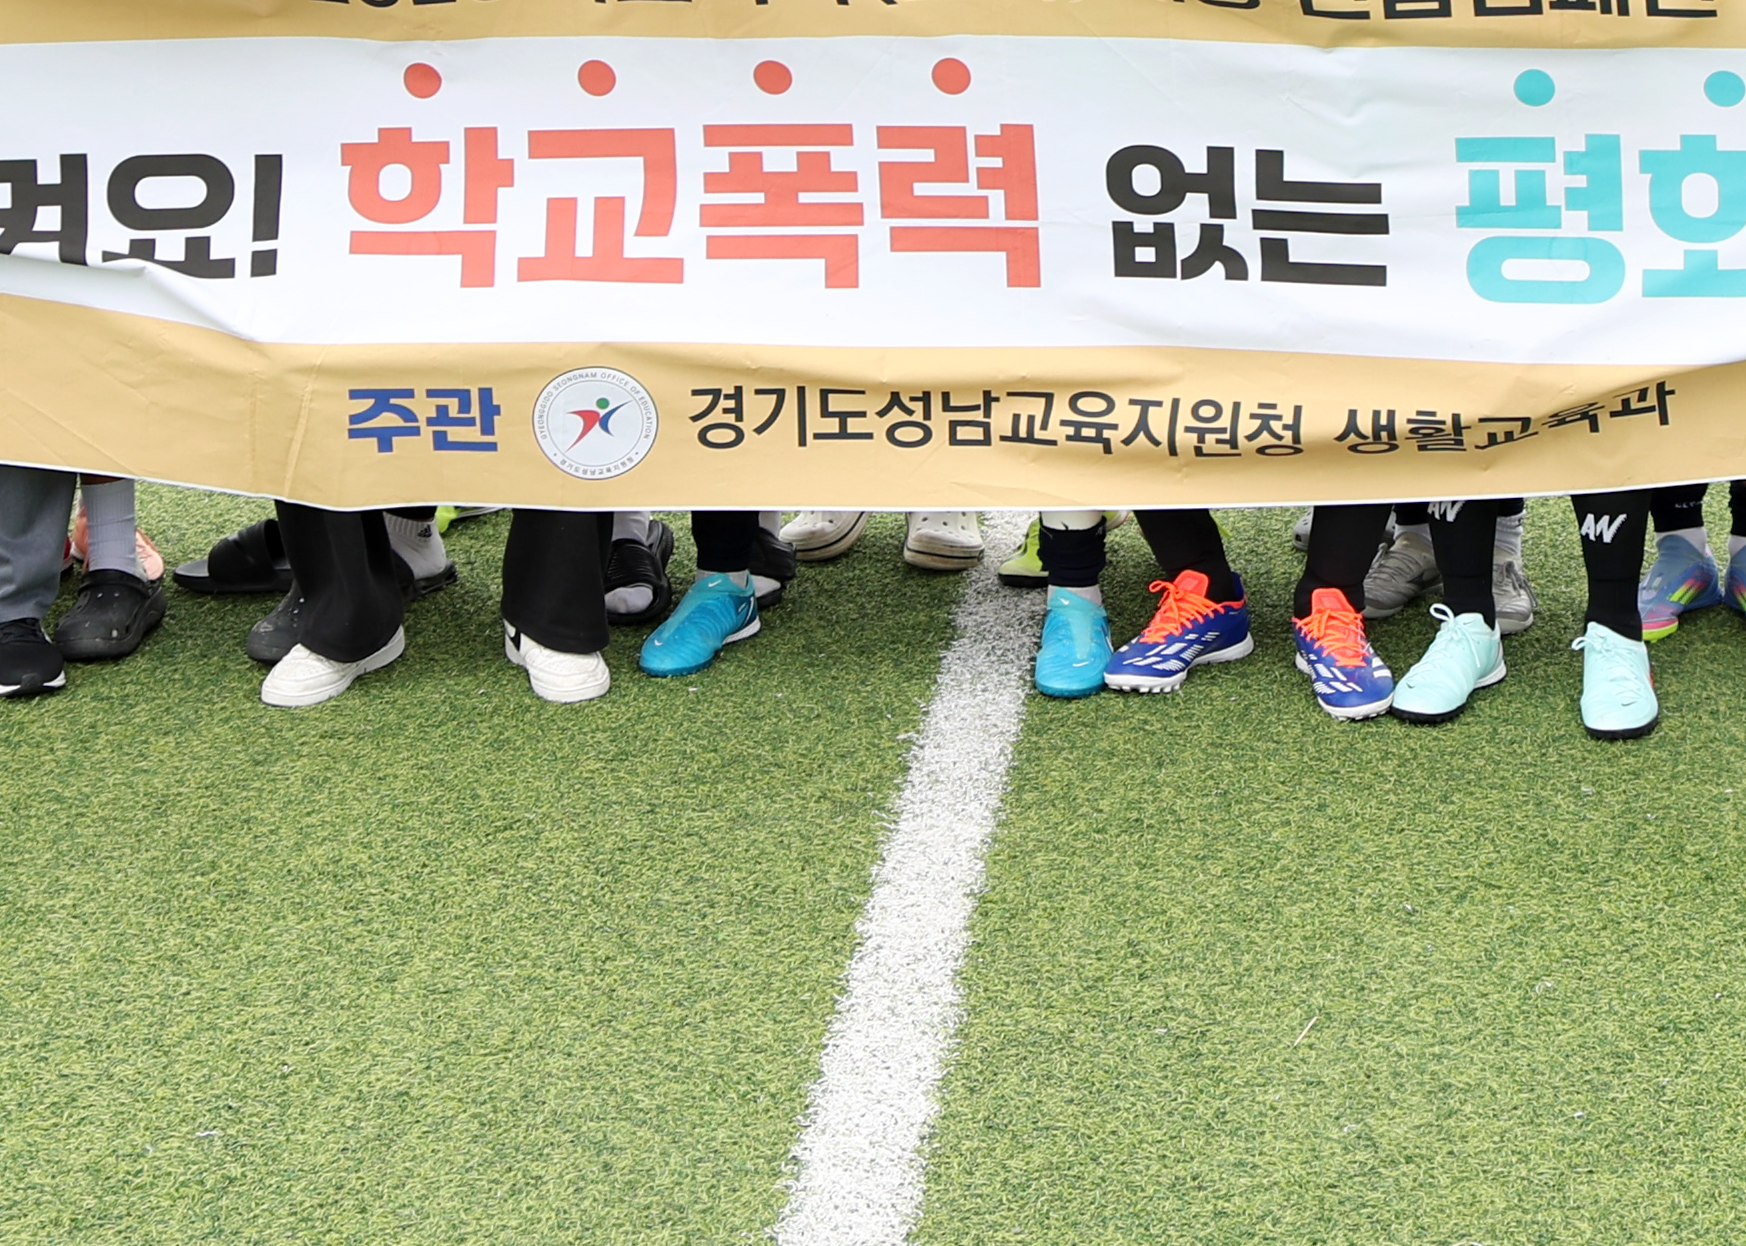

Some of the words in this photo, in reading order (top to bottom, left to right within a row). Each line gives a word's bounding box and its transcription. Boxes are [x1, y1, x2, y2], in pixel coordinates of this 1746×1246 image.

[339, 123, 1043, 289] 학교폭력
[1105, 143, 1390, 287] 없는
[347, 386, 502, 453] 주관
[688, 384, 1305, 458] 경기도성남교육지원청
[1332, 380, 1676, 455] 생활교육과
[553, 372, 597, 391] SEONGNAM
[600, 372, 628, 387] OFFICE
[630, 386, 641, 395] OF
[639, 396, 653, 440] EDUCATION
